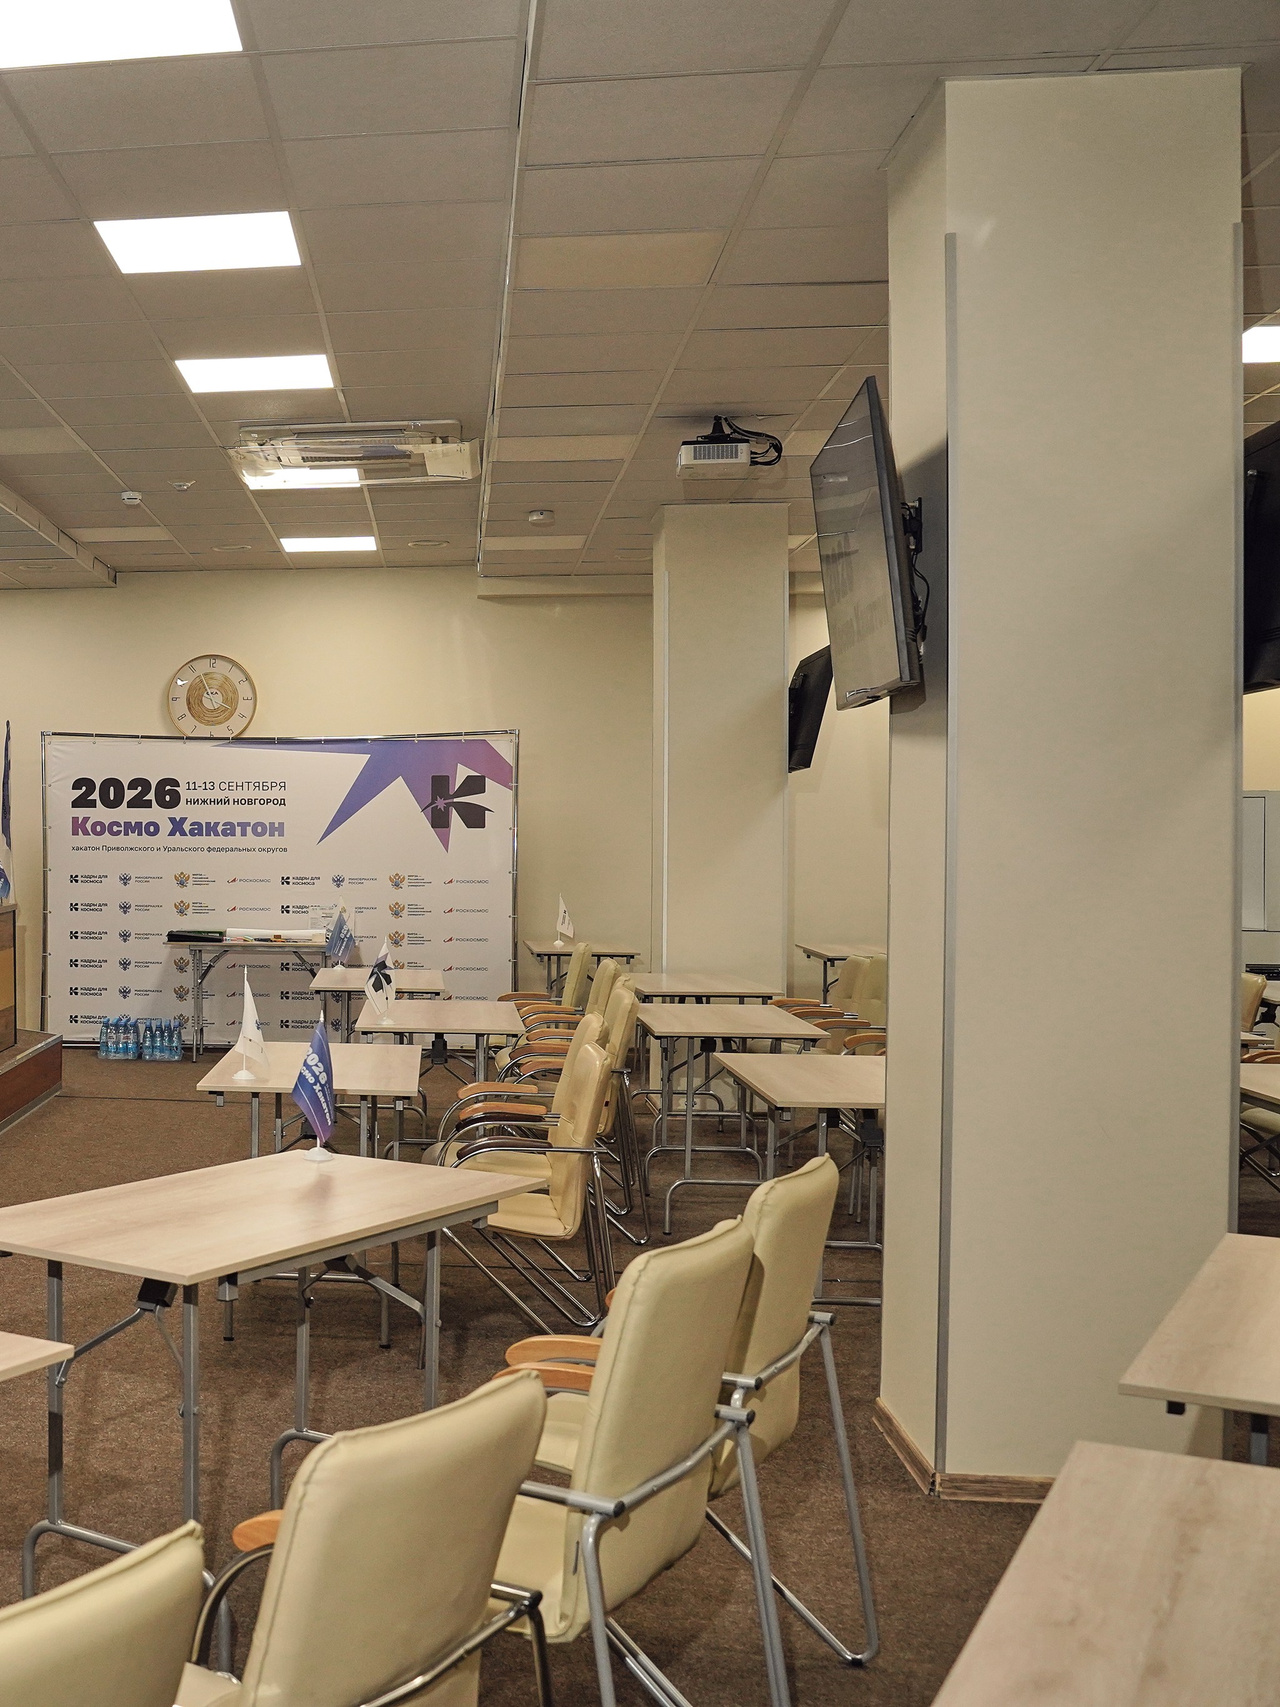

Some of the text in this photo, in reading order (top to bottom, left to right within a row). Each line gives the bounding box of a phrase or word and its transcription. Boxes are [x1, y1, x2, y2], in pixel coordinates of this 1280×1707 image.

[209, 658, 217, 668] 12
[185, 781, 286, 791] 11-13 СЕНТЯБРЯ
[71, 777, 181, 809] 2026
[185, 796, 286, 806] НИЖНИЙ НОВГОРОД
[71, 816, 285, 837] Космо Хакатон
[162, 845, 204, 853] Уральского
[301, 1066, 315, 1084] смо
[313, 1082, 331, 1126] Хакатон
